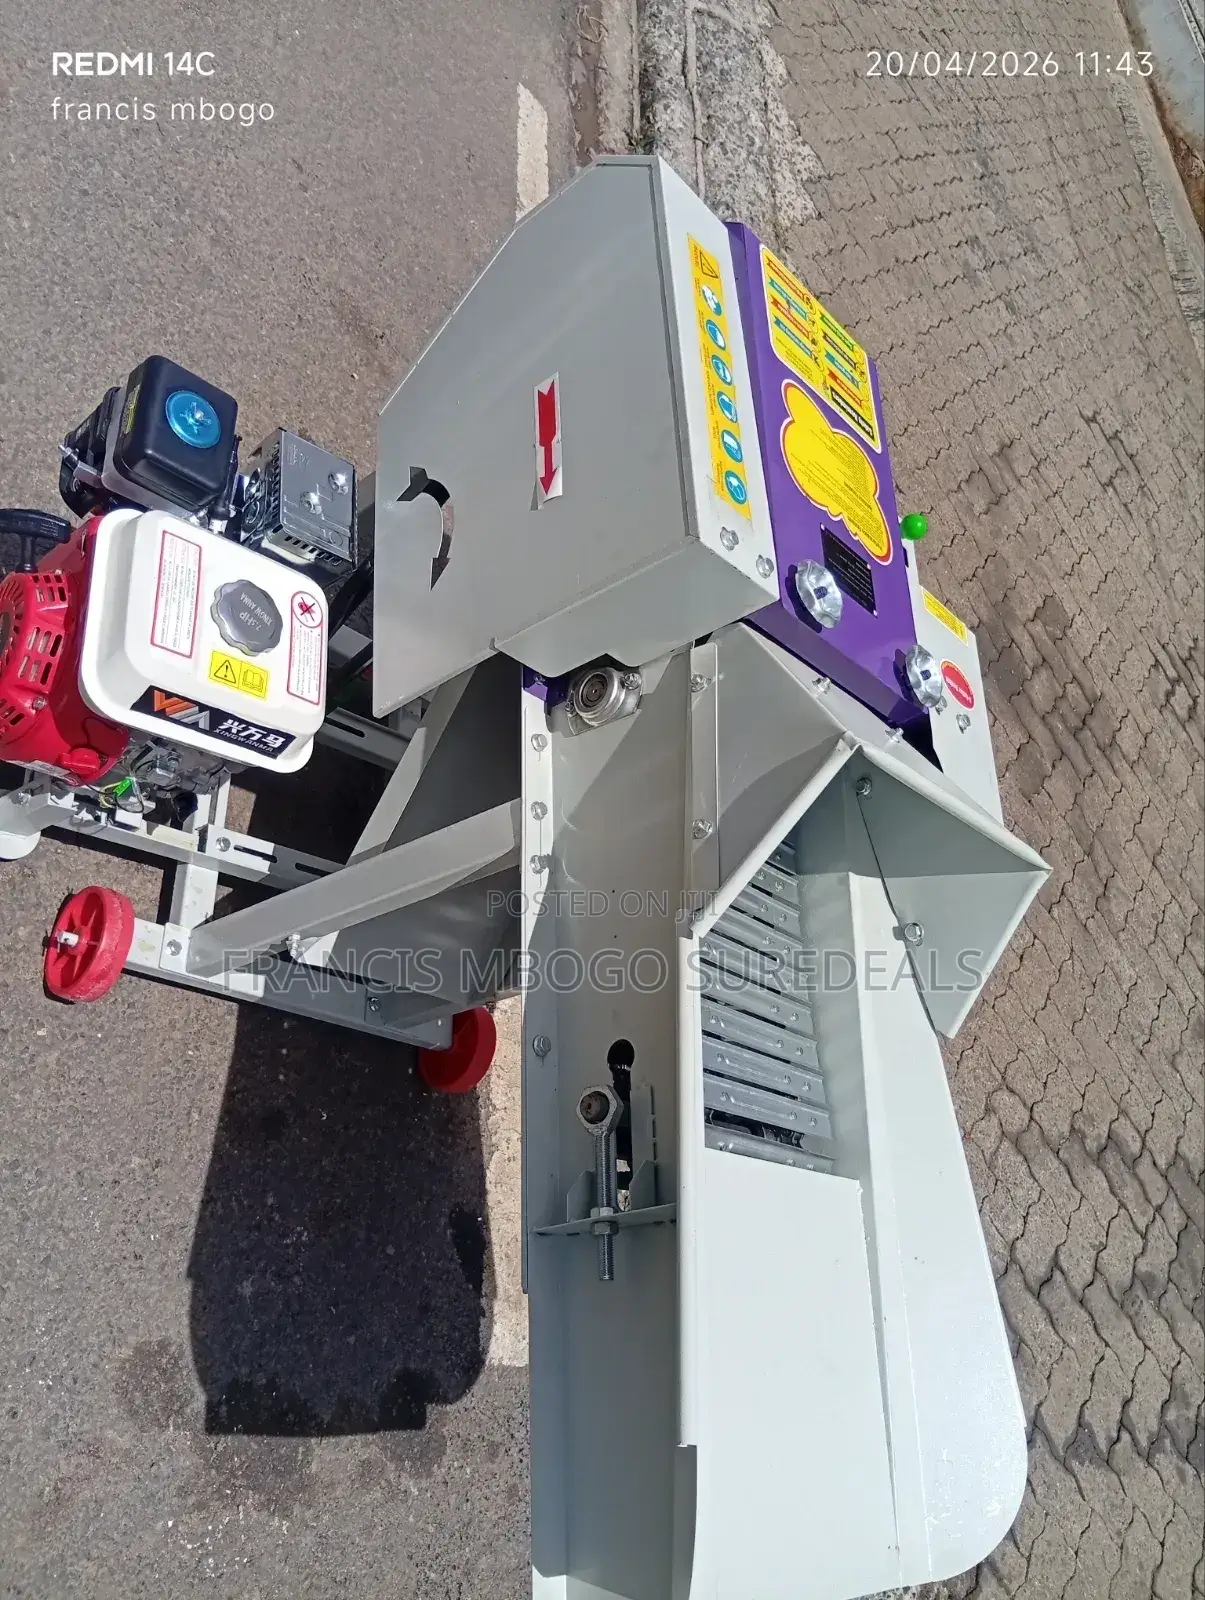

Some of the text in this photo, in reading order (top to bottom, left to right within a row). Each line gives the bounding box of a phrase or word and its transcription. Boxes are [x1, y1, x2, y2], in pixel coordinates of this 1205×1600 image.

[239, 612, 262, 631] 7.5HP
[213, 728, 275, 752] XINGWANMA
[218, 718, 286, 748] 兴万马
